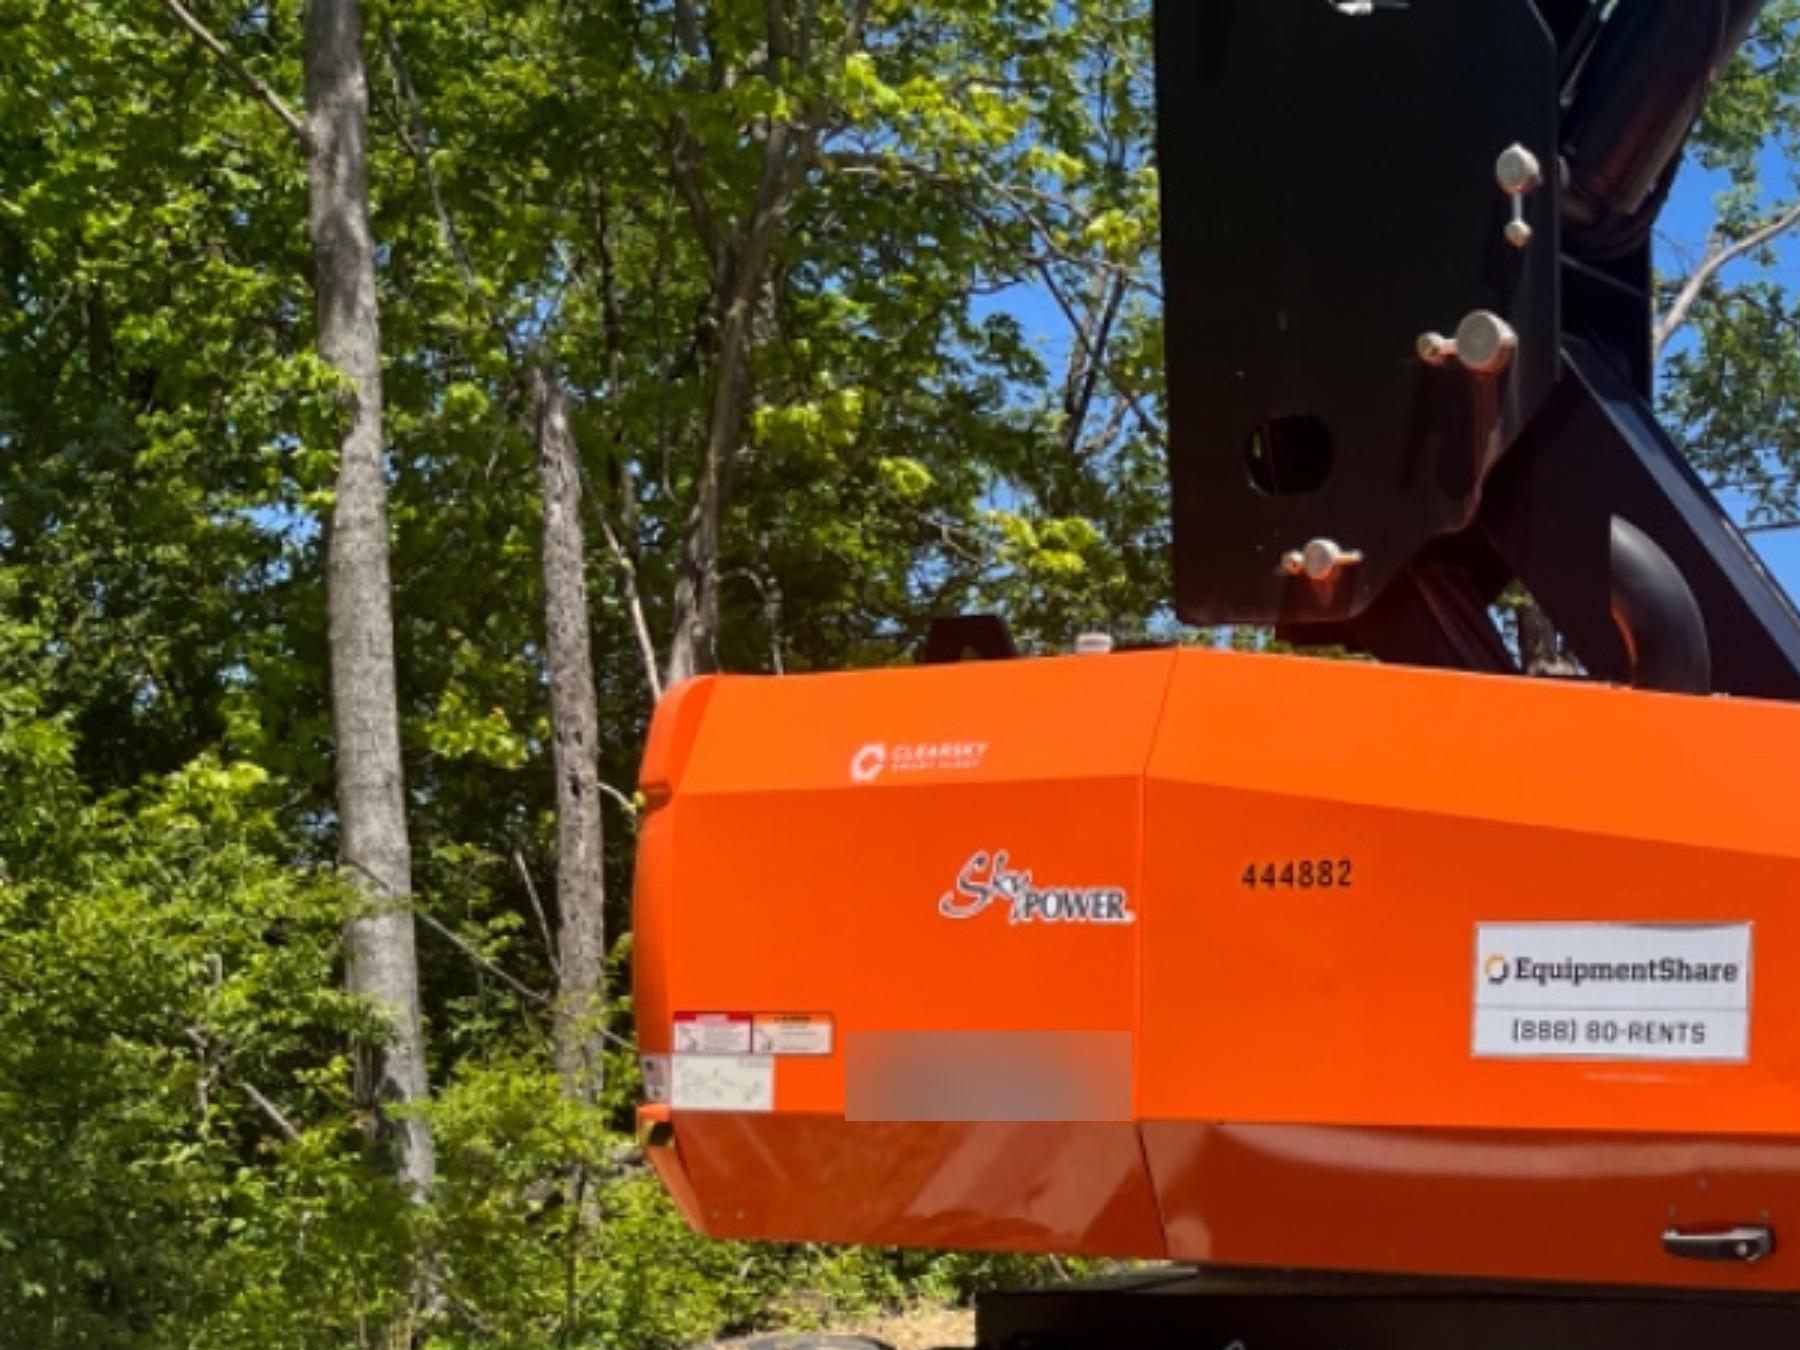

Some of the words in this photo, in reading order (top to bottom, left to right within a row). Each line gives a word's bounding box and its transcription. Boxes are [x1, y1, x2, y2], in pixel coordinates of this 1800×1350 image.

[1241, 858, 1352, 890] 444882
[1513, 956, 1739, 986] EquipmentShare
[1512, 1018, 1577, 1044] (888)
[1585, 1019, 1706, 1045] 80-RENTS
